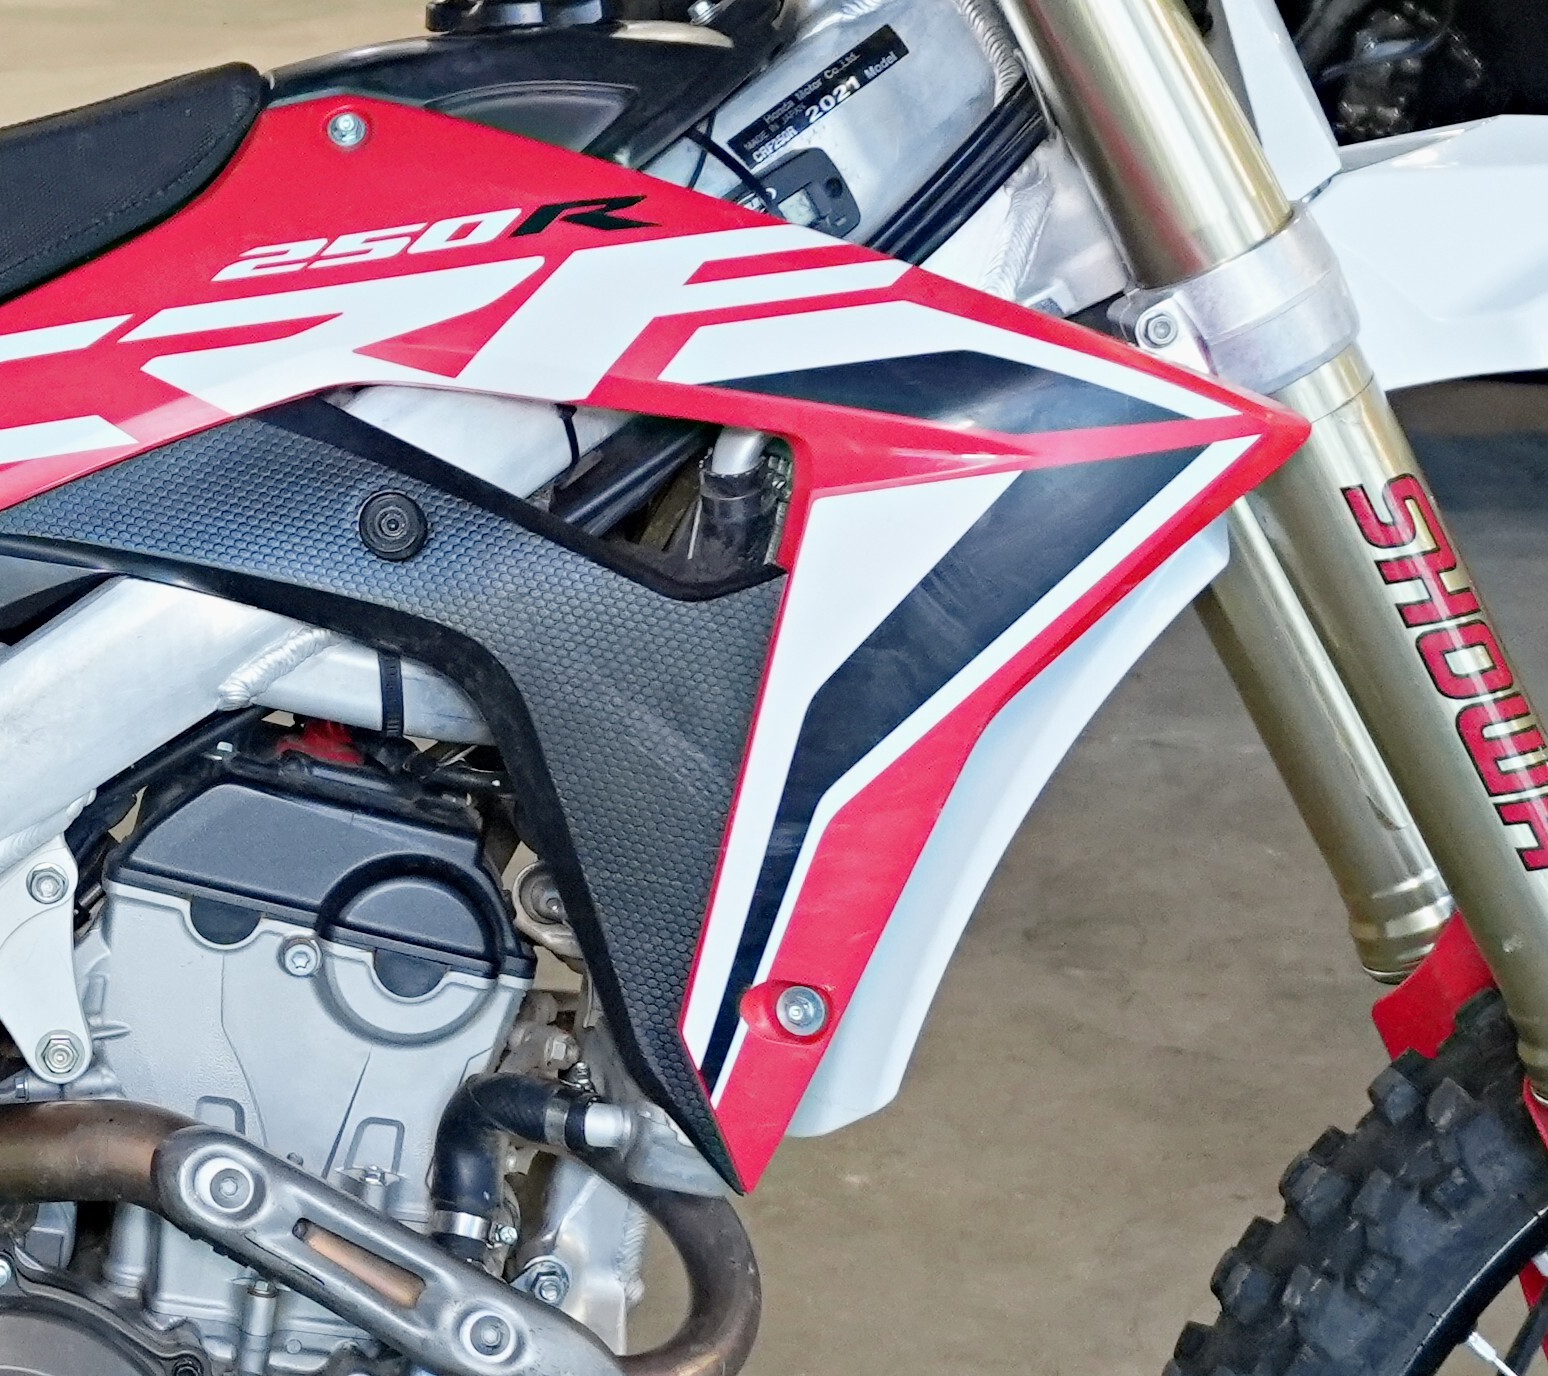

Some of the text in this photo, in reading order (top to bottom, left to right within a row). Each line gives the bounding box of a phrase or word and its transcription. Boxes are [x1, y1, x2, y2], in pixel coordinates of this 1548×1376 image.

[804, 50, 899, 124] 2021 Model
[212, 196, 661, 283] 250R
